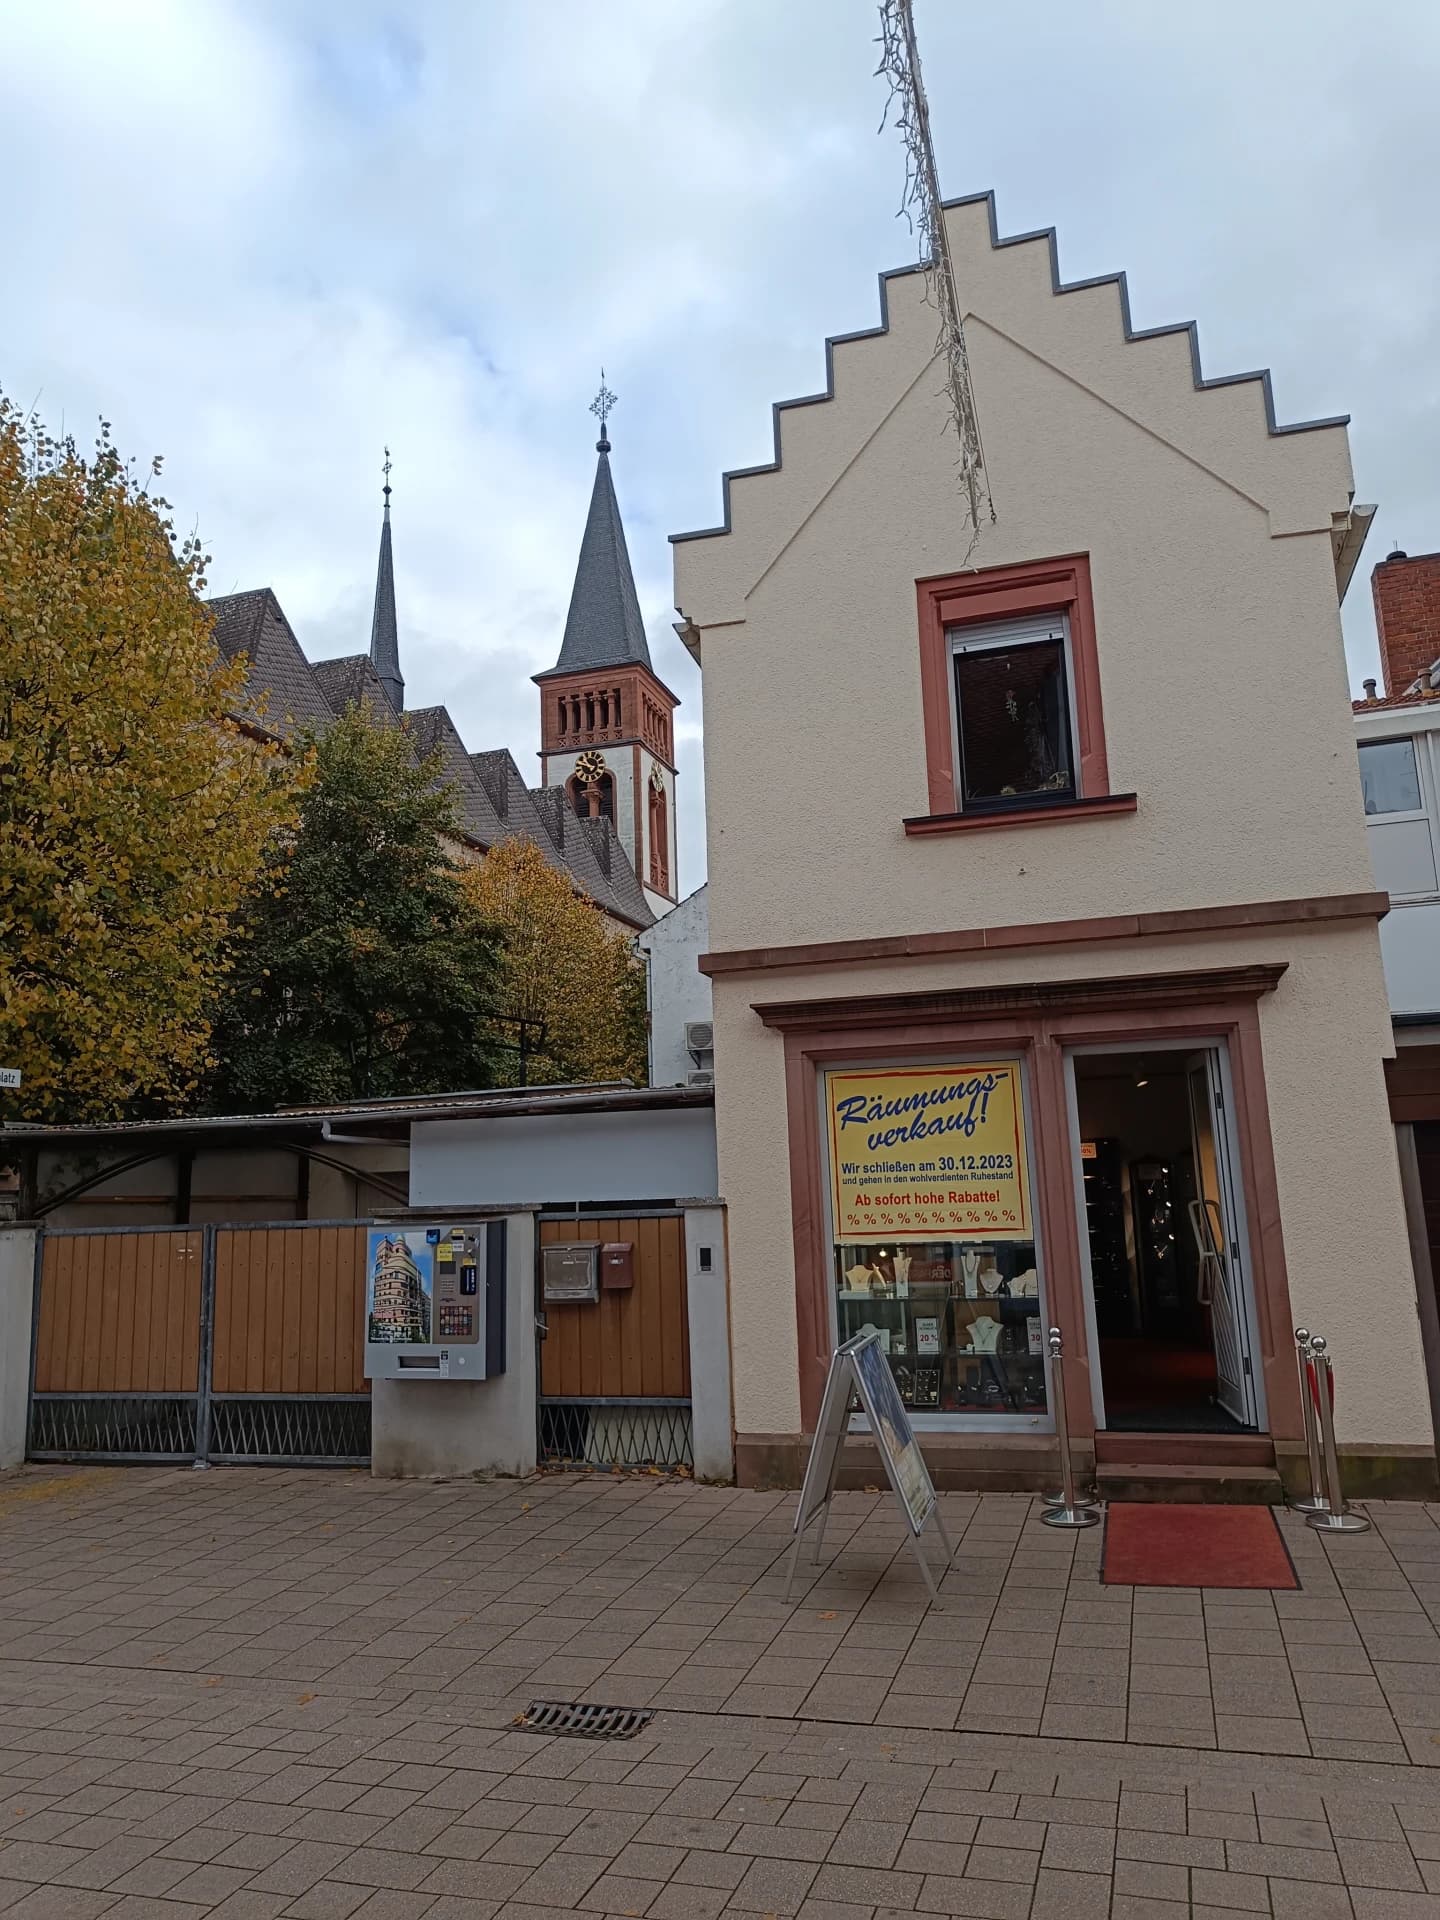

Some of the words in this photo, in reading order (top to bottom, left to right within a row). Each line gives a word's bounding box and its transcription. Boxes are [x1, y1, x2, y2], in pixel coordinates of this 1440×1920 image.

[837, 1072, 1008, 1130] Räumungs-
[868, 1093, 988, 1150] verkauf!
[842, 1162, 860, 1174] Wir
[863, 1159, 915, 1174] schließen
[919, 1161, 935, 1171] am
[938, 1154, 1013, 1171] 30.12.2023
[842, 1175, 857, 1185] und
[859, 1176, 882, 1186] gehen
[884, 1175, 891, 1183] in
[894, 1174, 908, 1183] den
[910, 1172, 969, 1183] wohlverdienten
[971, 1171, 1013, 1181] Ruhestand
[855, 1194, 871, 1206] Ab
[875, 1192, 911, 1205] sofort
[914, 1192, 944, 1204] hohe
[949, 1190, 1000, 1203] Rabatte!
[847, 1214, 859, 1225] %
[864, 1213, 876, 1225] %
[881, 1213, 893, 1225] %
[898, 1212, 910, 1224] %
[915, 1212, 928, 1224] %
[932, 1212, 945, 1223] %
[949, 1211, 962, 1223] %
[967, 1211, 979, 1223] %
[985, 1210, 997, 1222] %
[1002, 1209, 1015, 1221] %
